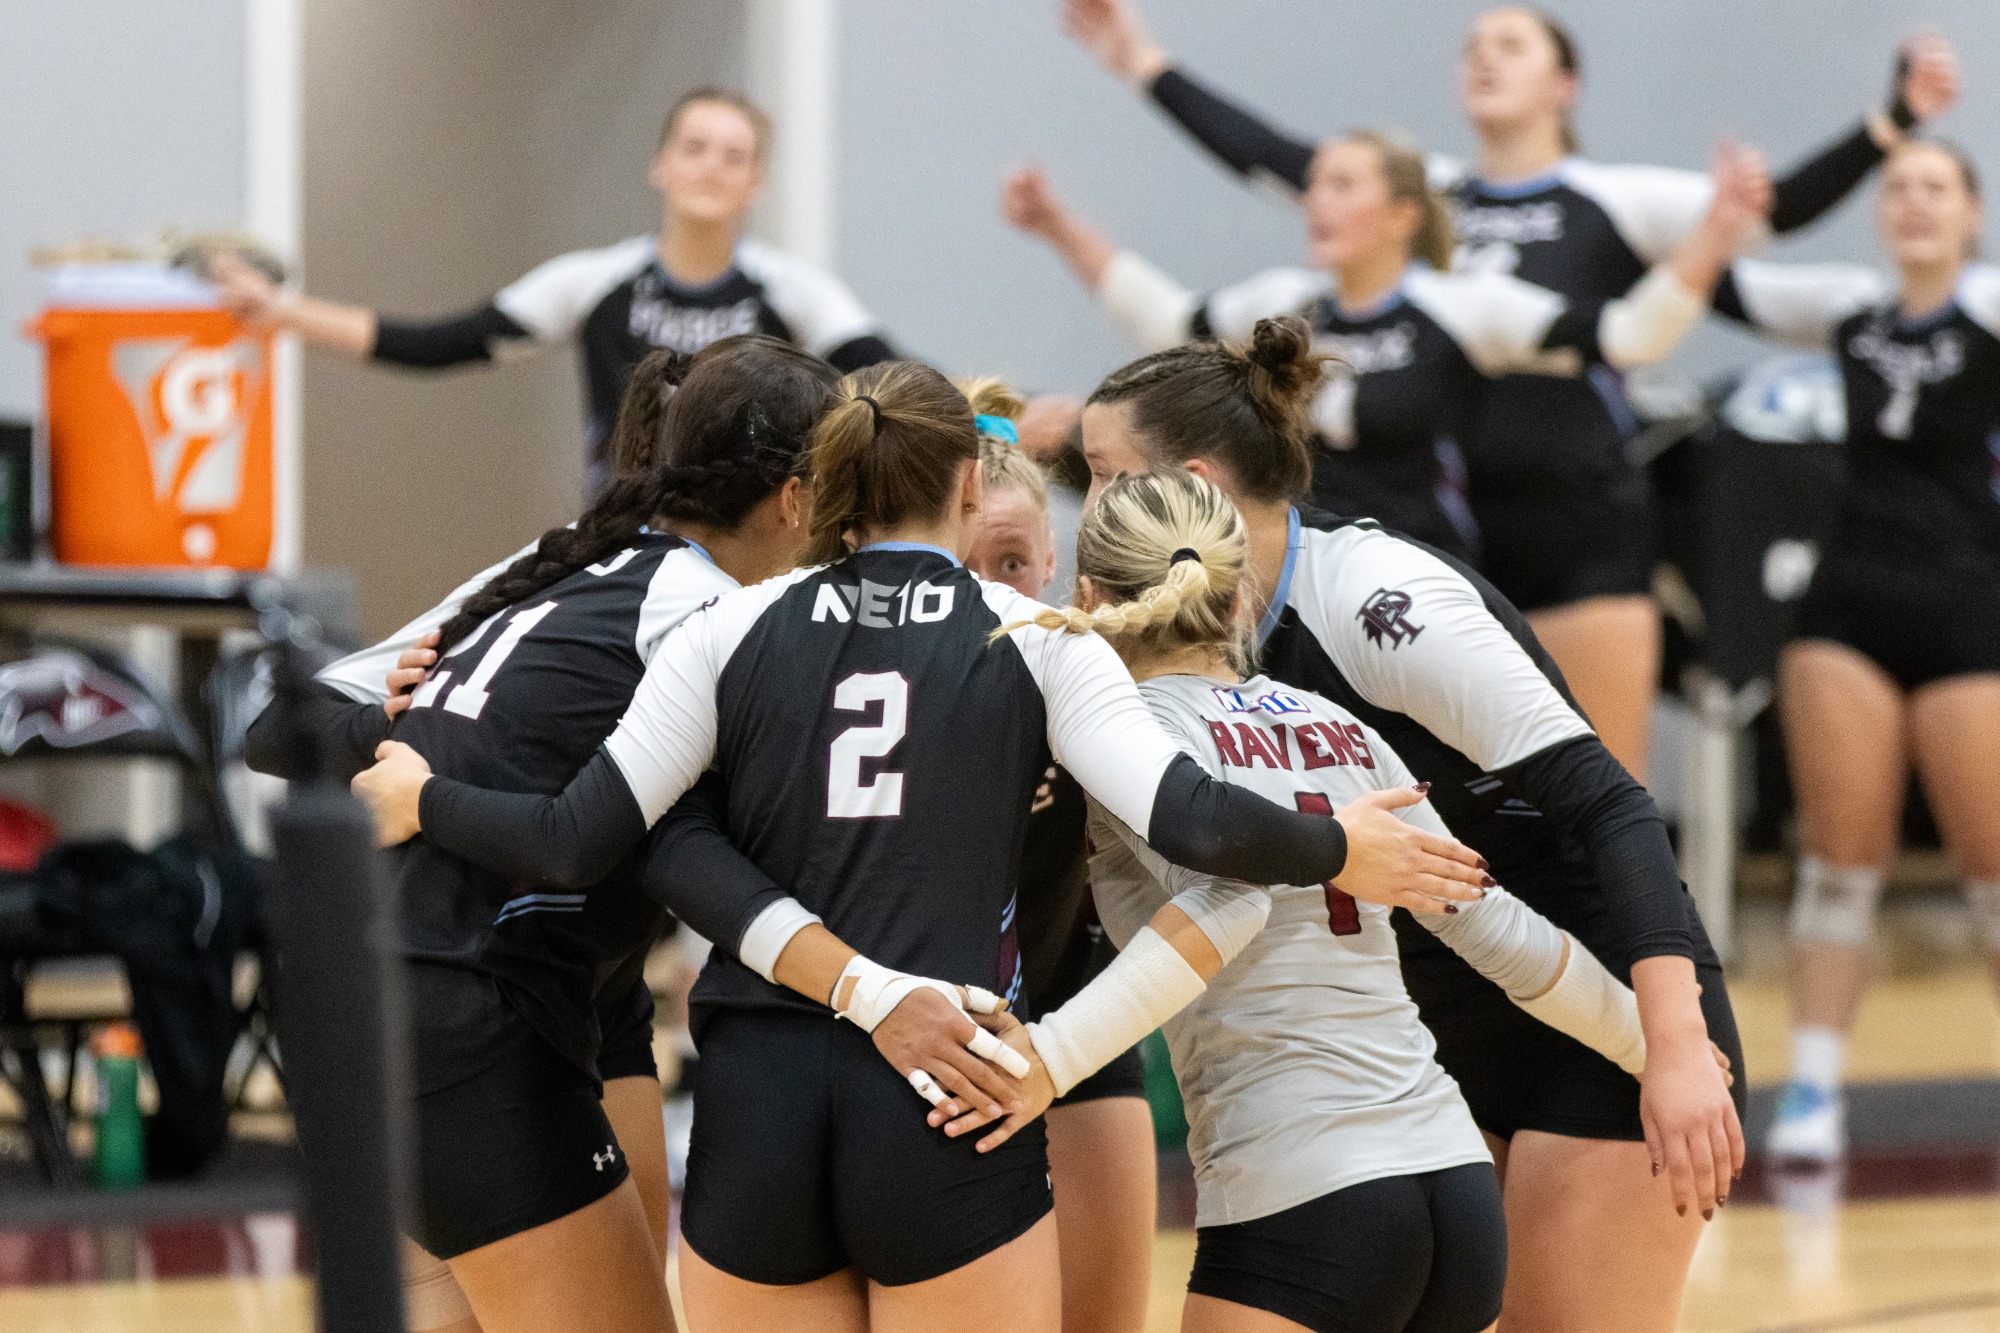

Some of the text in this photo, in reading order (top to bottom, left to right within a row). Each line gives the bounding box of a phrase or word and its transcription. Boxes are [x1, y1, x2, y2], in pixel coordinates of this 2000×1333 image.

[811, 578, 955, 629] NE10
[827, 670, 908, 818] 2
[1206, 719, 1376, 771] RAVENS
